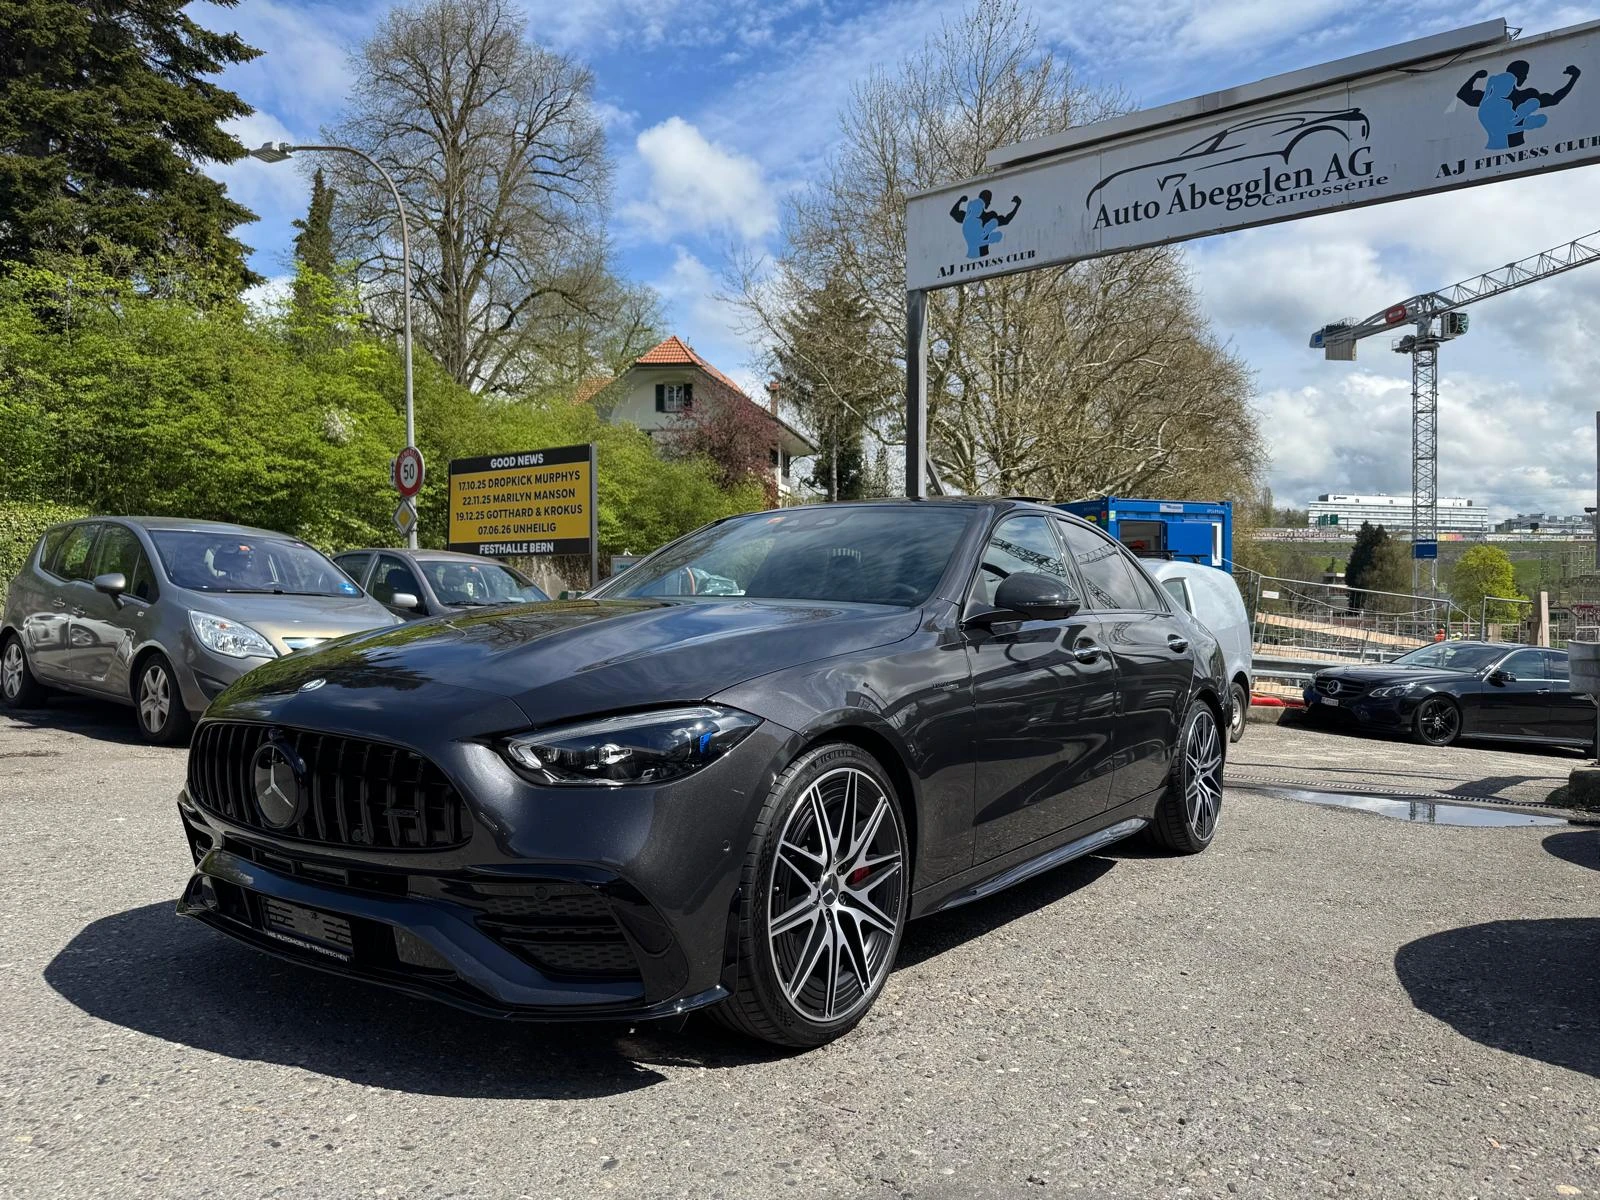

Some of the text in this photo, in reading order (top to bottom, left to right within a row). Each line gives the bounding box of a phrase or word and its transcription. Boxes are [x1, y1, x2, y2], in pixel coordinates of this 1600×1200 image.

[1435, 158, 1467, 179] AJ
[1474, 145, 1549, 170] FITNESS
[1093, 146, 1374, 230] Auto Abegglen AG
[1261, 174, 1389, 207] Carrosserie
[936, 250, 1036, 279] AJ FITNESS CLUB
[490, 453, 544, 469] GOOD NEWS
[403, 463, 415, 480] 50
[458, 470, 581, 492] 17.10.25 DROPKICK MURPHYS
[462, 488, 576, 506] 22.11.25 MARILYN MANSON
[456, 504, 583, 522] 19.12.25 GOTTHARD & KROKUS
[478, 522, 557, 536] 07.06.26 UNHEILIG
[479, 542, 554, 555] FESTHALLE BERN
